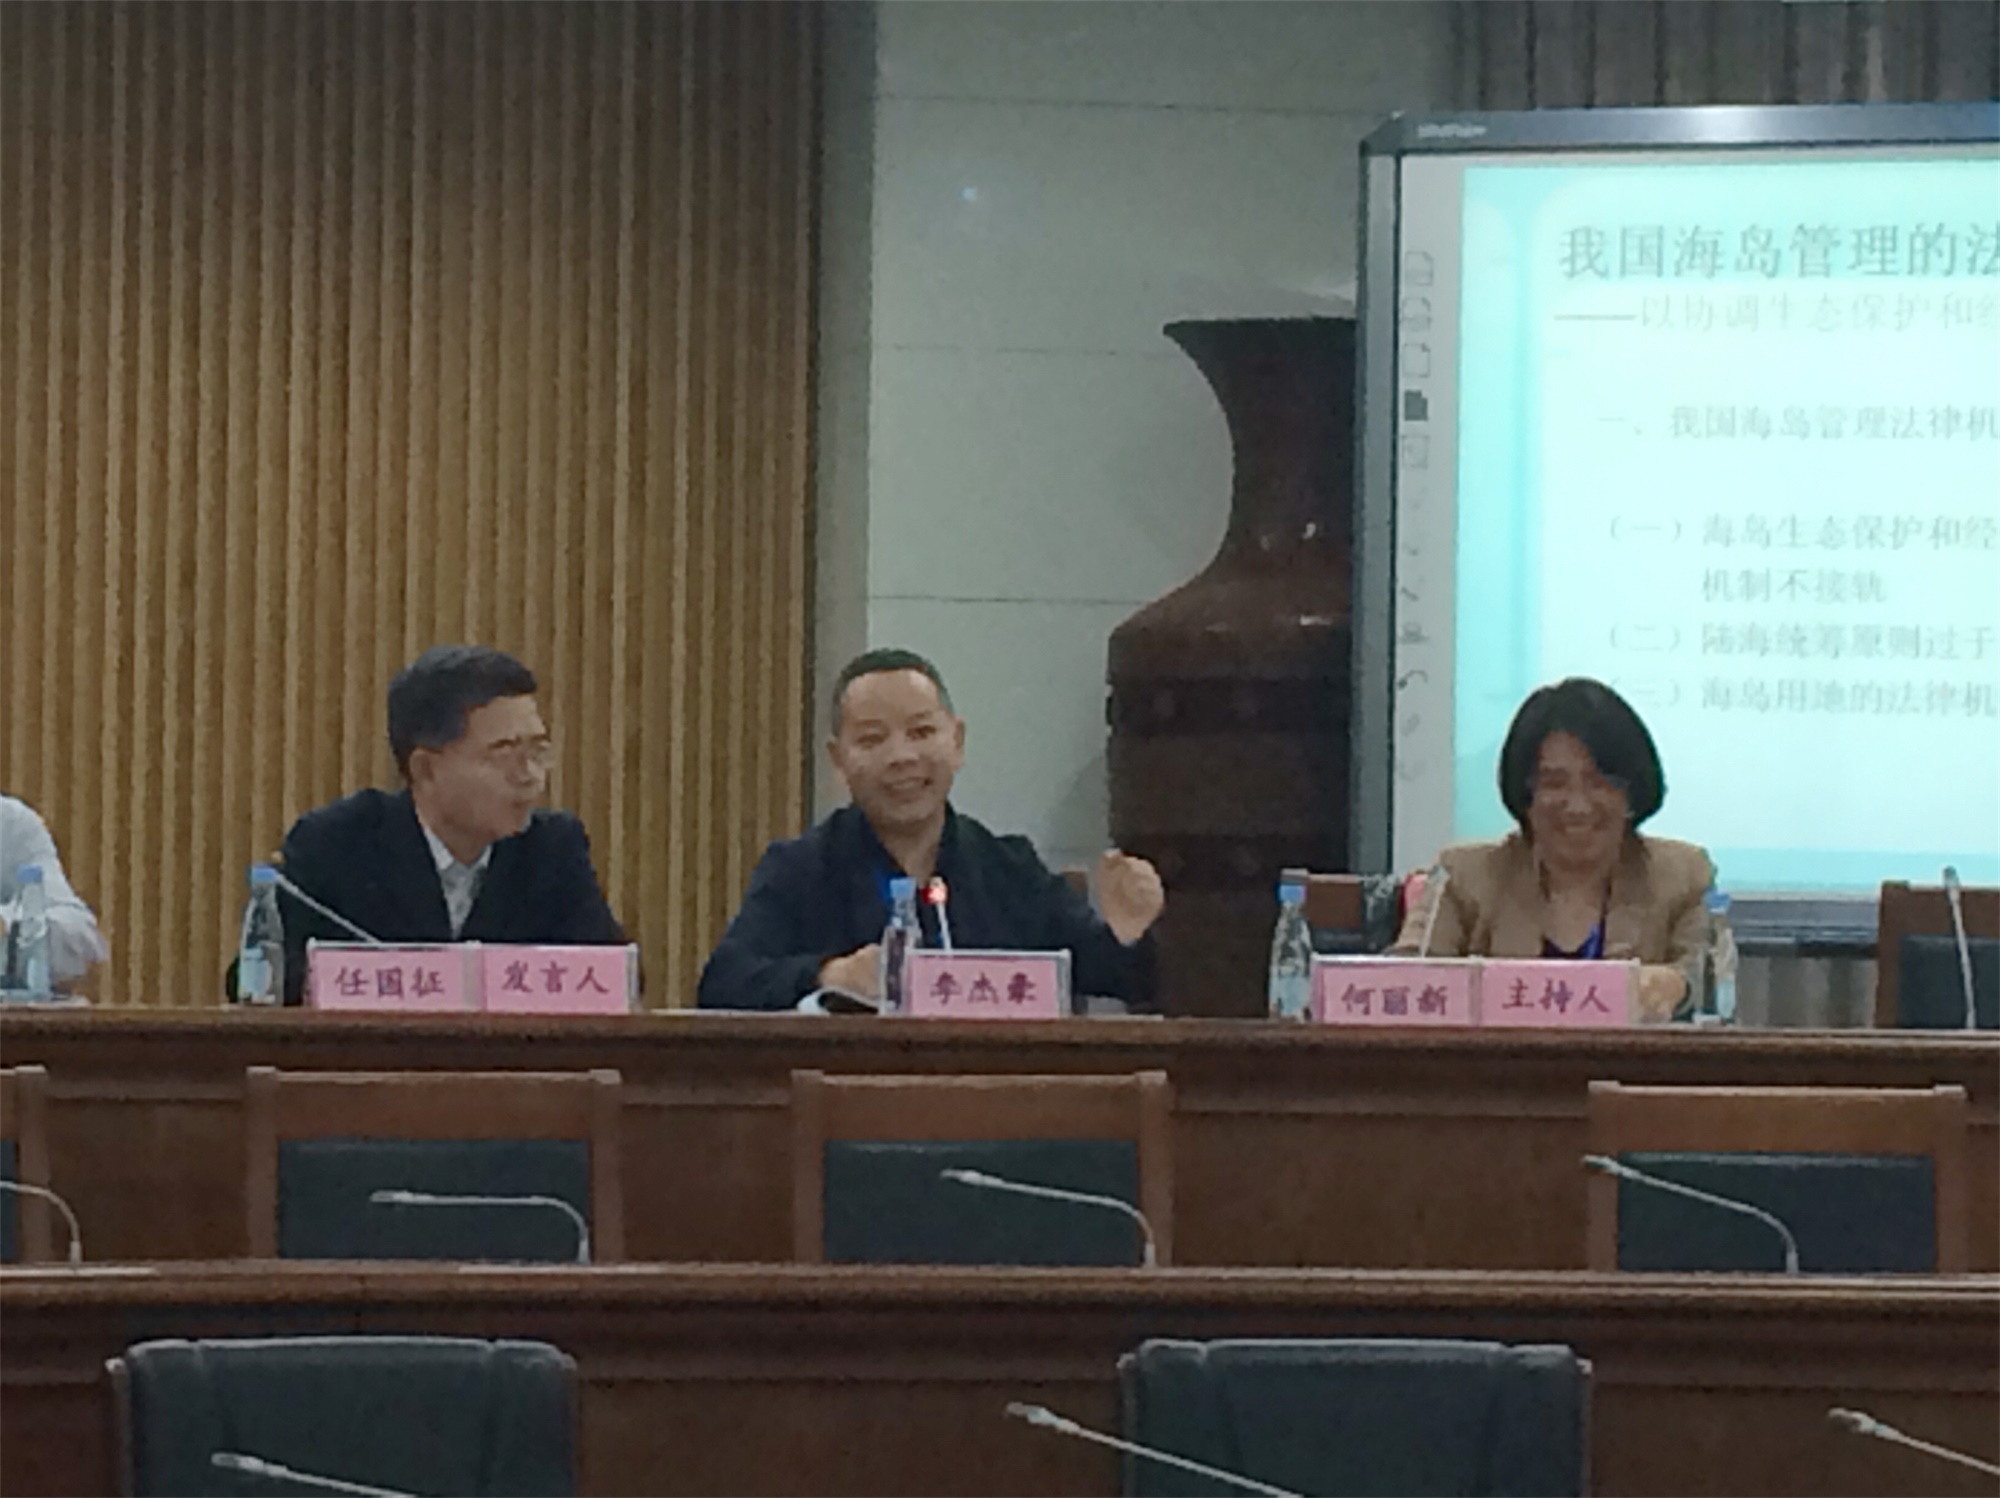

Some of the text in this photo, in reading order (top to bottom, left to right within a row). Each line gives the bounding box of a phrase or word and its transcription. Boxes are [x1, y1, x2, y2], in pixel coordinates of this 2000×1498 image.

[1558, 221, 2000, 279] 我国海岛管理的法
[1700, 567, 1888, 604] 机制不接轨
[501, 960, 610, 994] 发言人
[1340, 982, 1448, 1016] 何丽新
[1501, 977, 1611, 1015] 主持人
